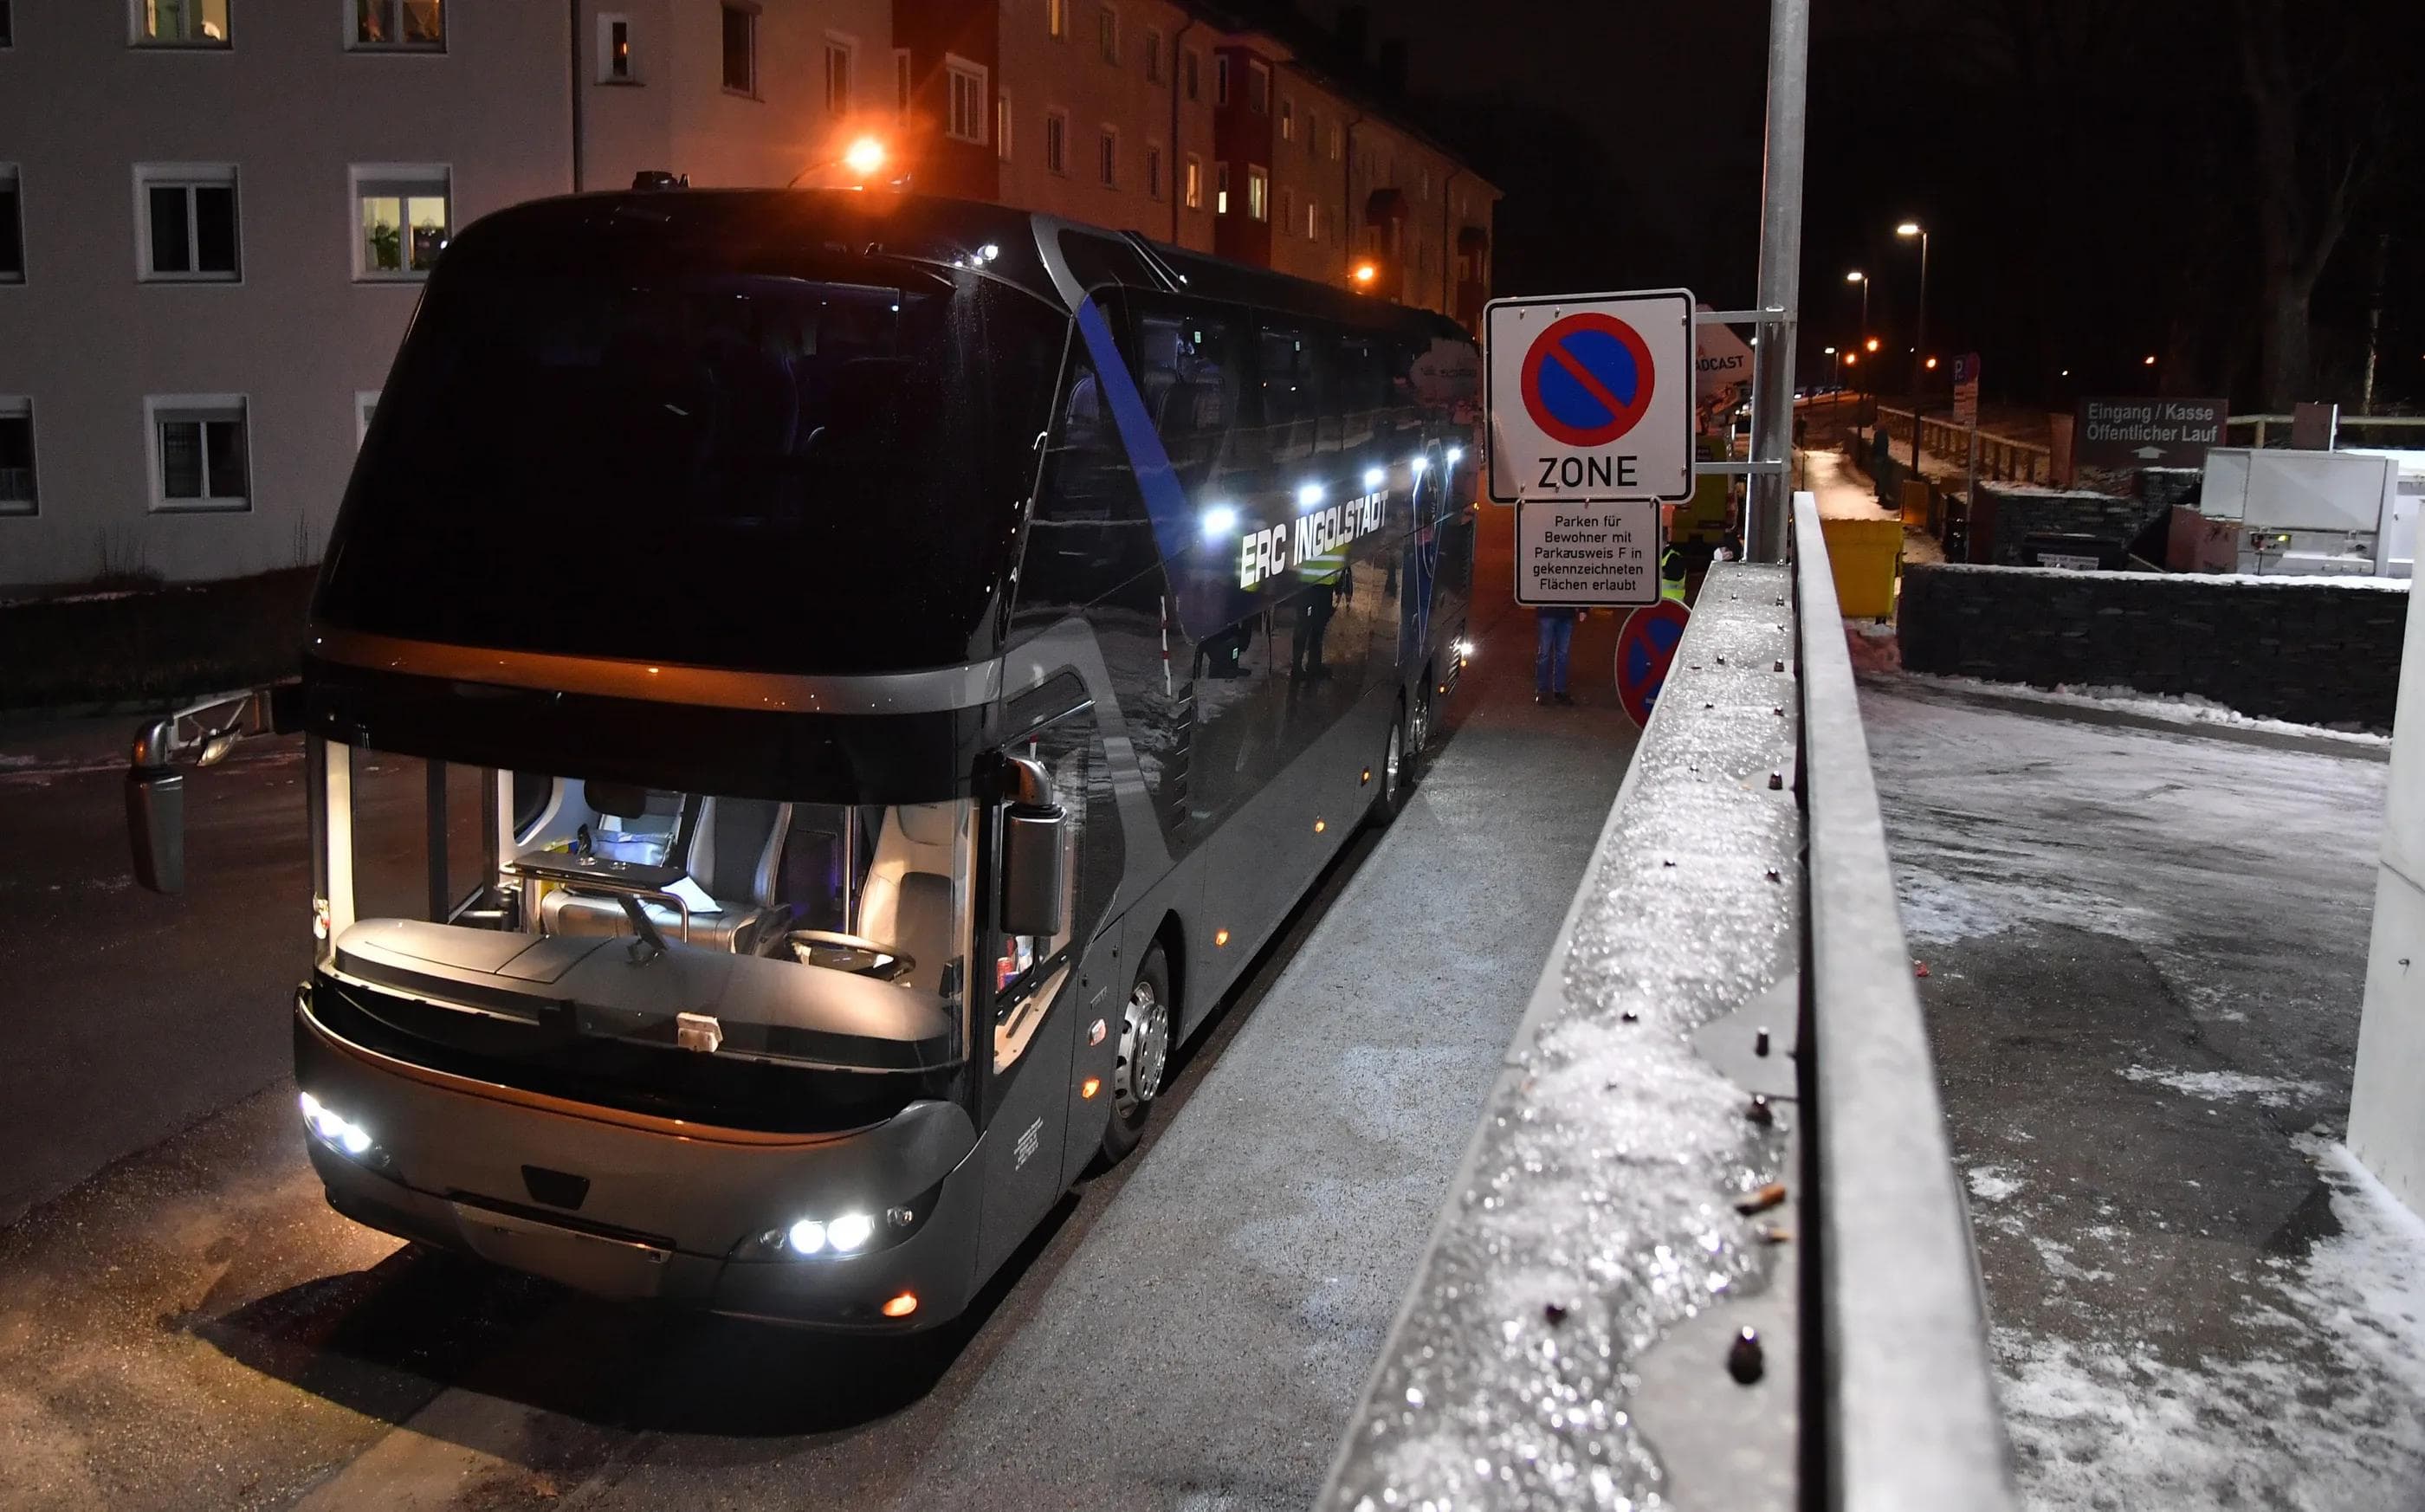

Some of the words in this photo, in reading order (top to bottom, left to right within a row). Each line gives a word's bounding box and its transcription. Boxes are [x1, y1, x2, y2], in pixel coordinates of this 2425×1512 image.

[2088, 403, 2151, 423] Eingang
[2155, 402, 2162, 420] /
[2165, 403, 2214, 421] Kasse
[2086, 421, 2177, 442] Öffentlicher
[2182, 424, 2218, 443] Lauf
[1537, 456, 1638, 488] ZONE
[1555, 515, 1599, 527] Parken
[1603, 515, 1621, 527] für
[1239, 523, 1286, 590] ERC
[1293, 489, 1389, 566] INGOLSTADT
[1544, 531, 1607, 543] Bewohner
[1612, 531, 1632, 543] mit
[1535, 546, 1613, 559] Parkausweis
[1618, 547, 1626, 559] F
[1631, 547, 1642, 559] in
[1533, 563, 1643, 577] gekennzeichneten
[1540, 578, 1588, 591] Flächen
[1592, 579, 1636, 591] erlaubt
